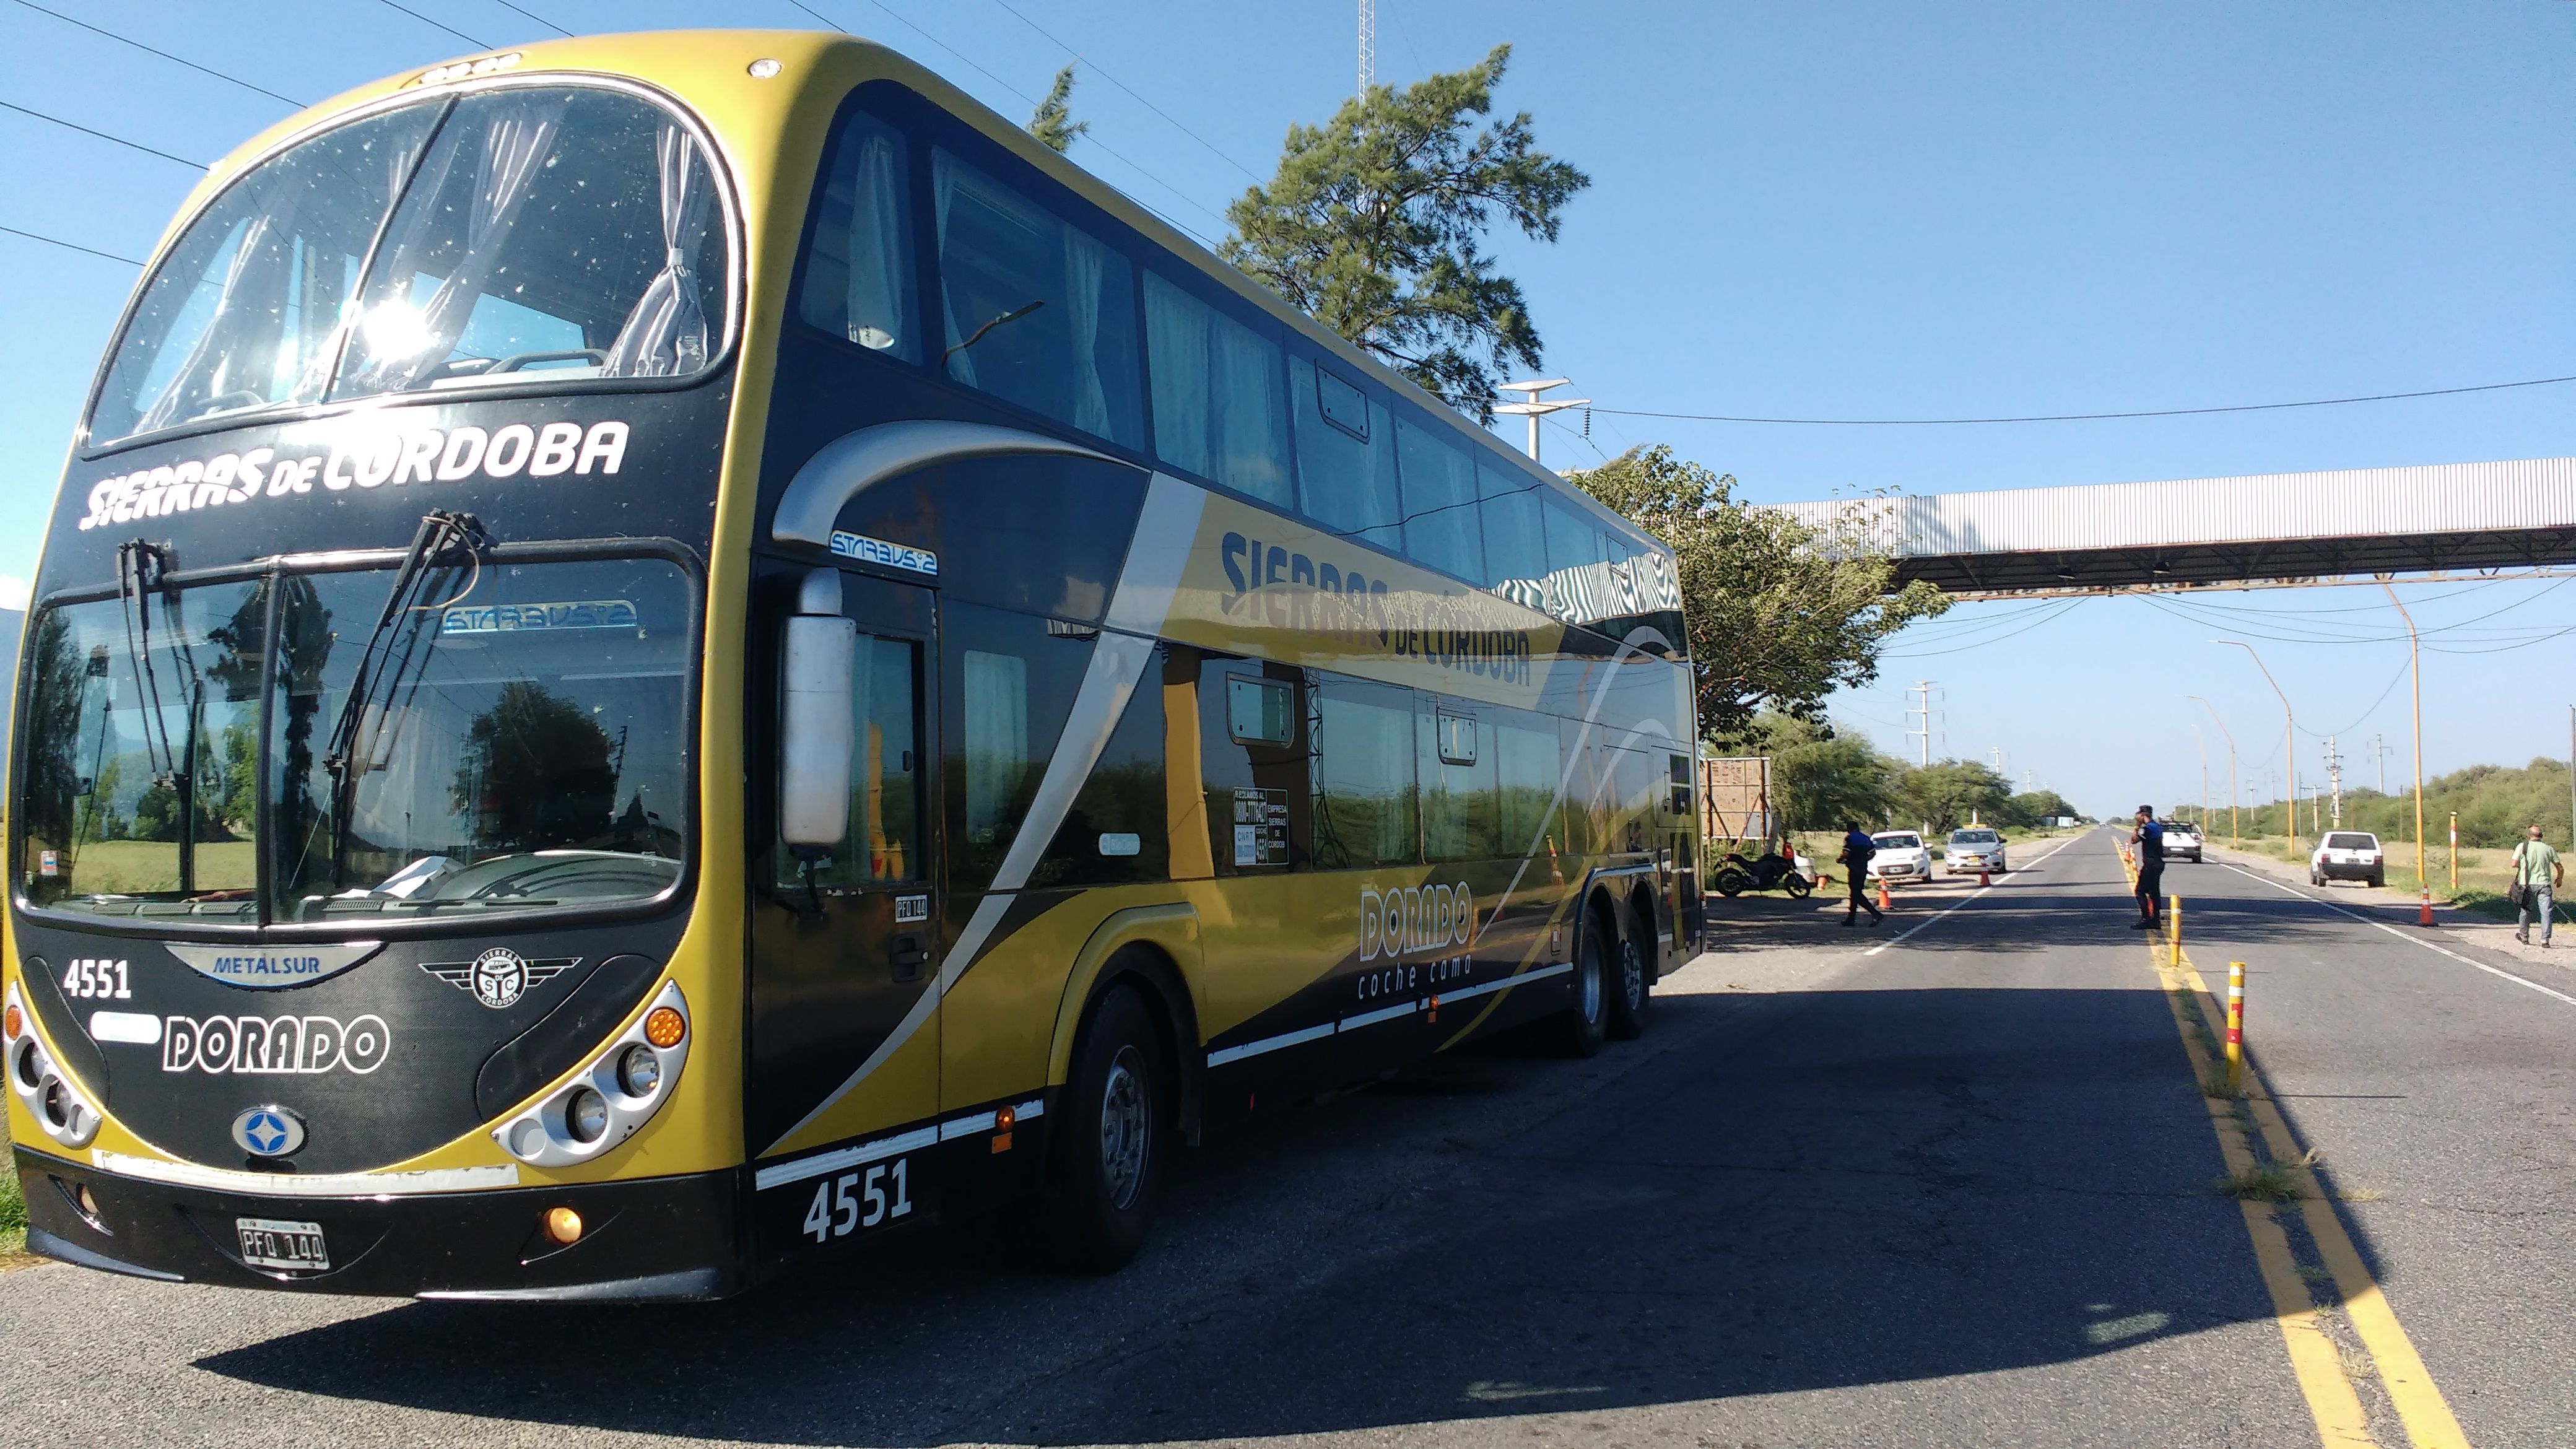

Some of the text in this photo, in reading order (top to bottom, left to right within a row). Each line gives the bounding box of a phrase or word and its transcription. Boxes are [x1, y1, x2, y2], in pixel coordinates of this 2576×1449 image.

[78, 448, 274, 531] SIERRAS
[266, 456, 323, 496] DE
[1222, 531, 1388, 651] SIERRAS
[1395, 610, 1419, 659] DE
[1268, 804, 1287, 813] EMPRESA
[1268, 817, 1286, 826] SIERRAS
[1275, 829, 1281, 837] DE
[913, 900, 926, 916] 144
[1360, 881, 1472, 962] DORADO
[213, 957, 320, 973] METALSUR
[480, 950, 518, 964] SIERRAS
[64, 959, 131, 998] 4551
[1359, 954, 1471, 999] coche cama
[481, 993, 518, 1006] CORDOBA
[162, 1014, 391, 1074] DORADO
[803, 1158, 911, 1243] 4551
[284, 1235, 323, 1260] 144
